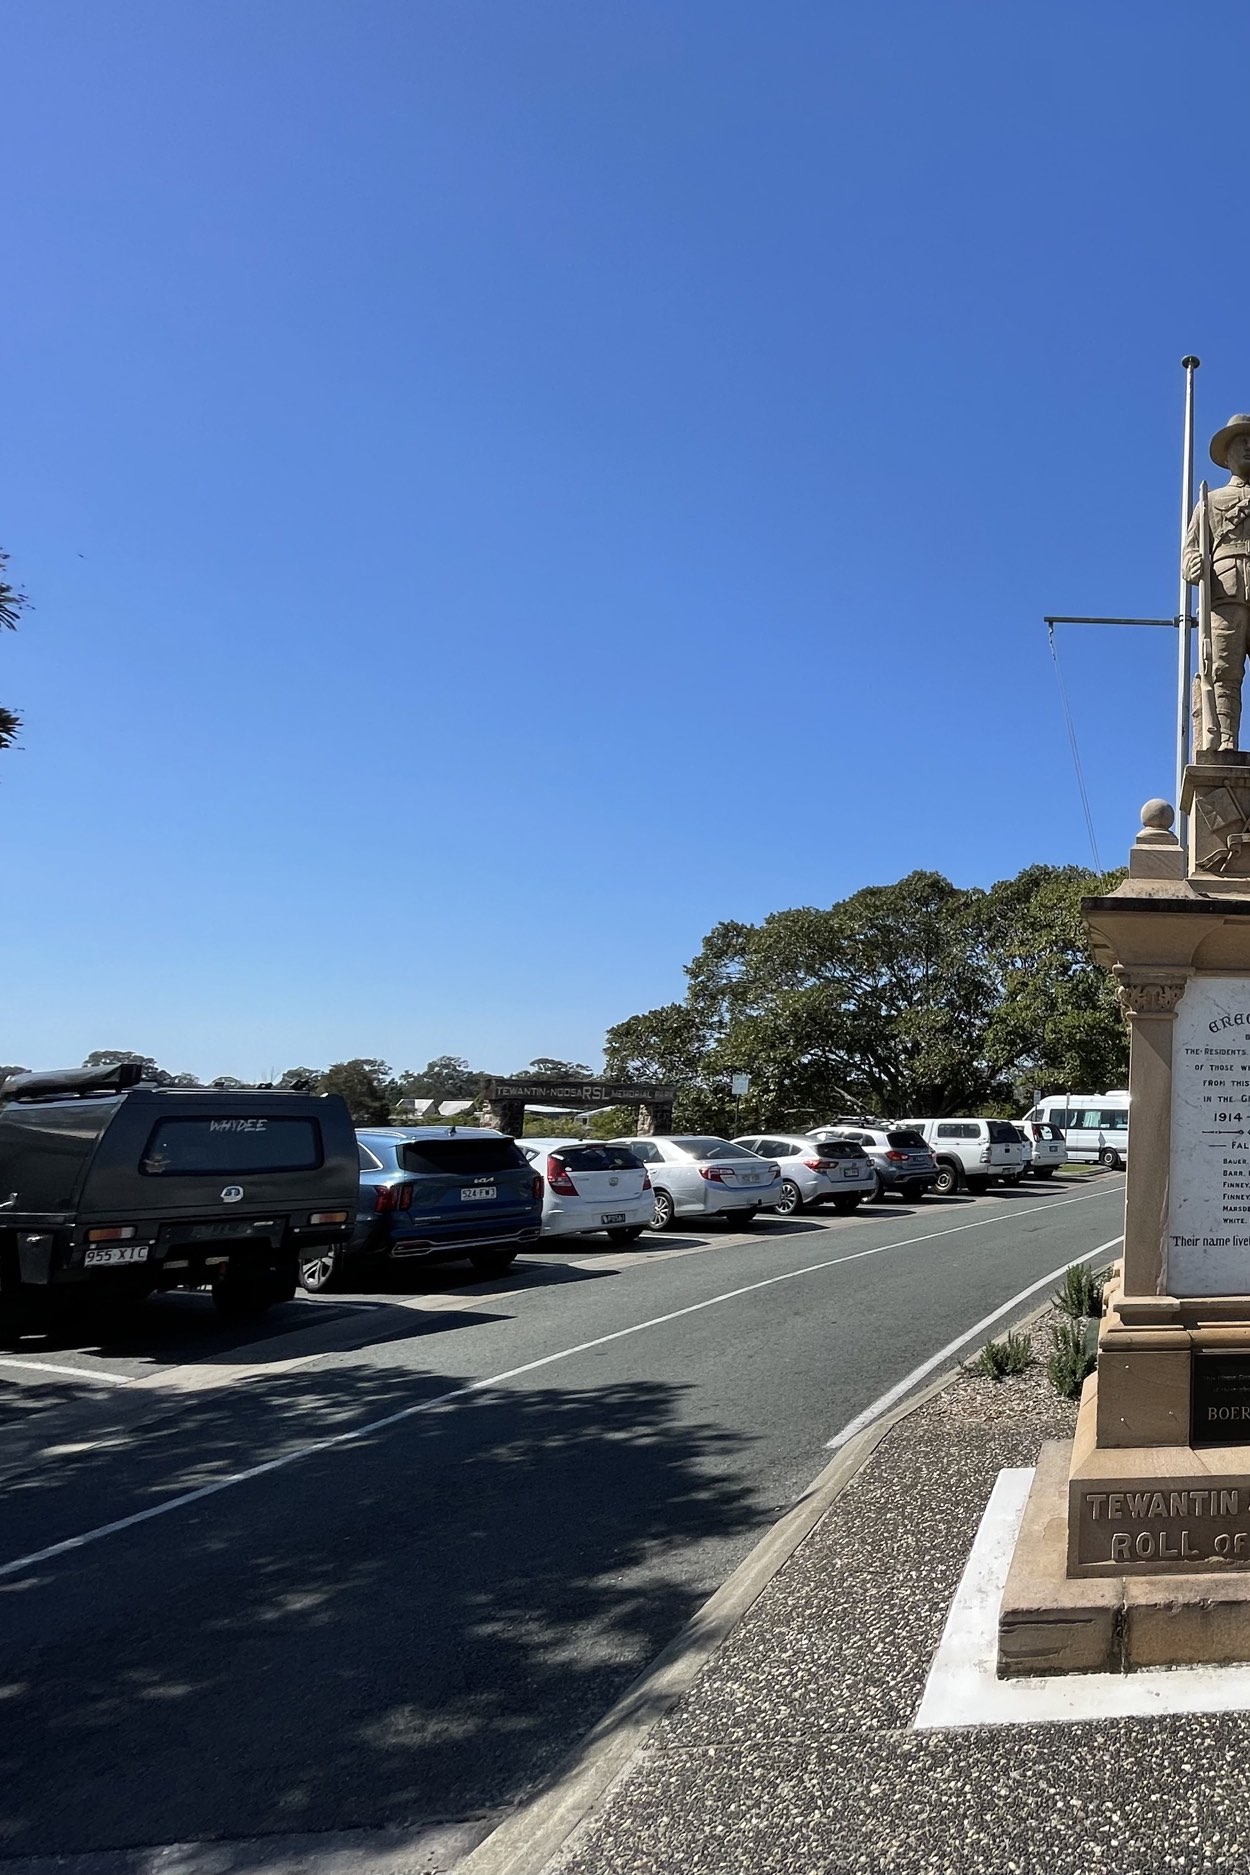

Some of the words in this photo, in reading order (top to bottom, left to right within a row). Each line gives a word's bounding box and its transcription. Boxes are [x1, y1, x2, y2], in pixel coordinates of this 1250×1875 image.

[582, 1087, 610, 1100] RSL
[611, 1089, 652, 1099] MEMORIAL
[1214, 1112, 1243, 1122] 1914
[210, 1119, 268, 1132] WHYDEE
[1203, 1239, 1230, 1247] name
[87, 1249, 113, 1263] 955
[117, 1247, 148, 1260] XIC
[1087, 1489, 1239, 1520] TEWANTIN
[1111, 1531, 1199, 1560] ROLL
[1214, 1533, 1248, 1554] OF
